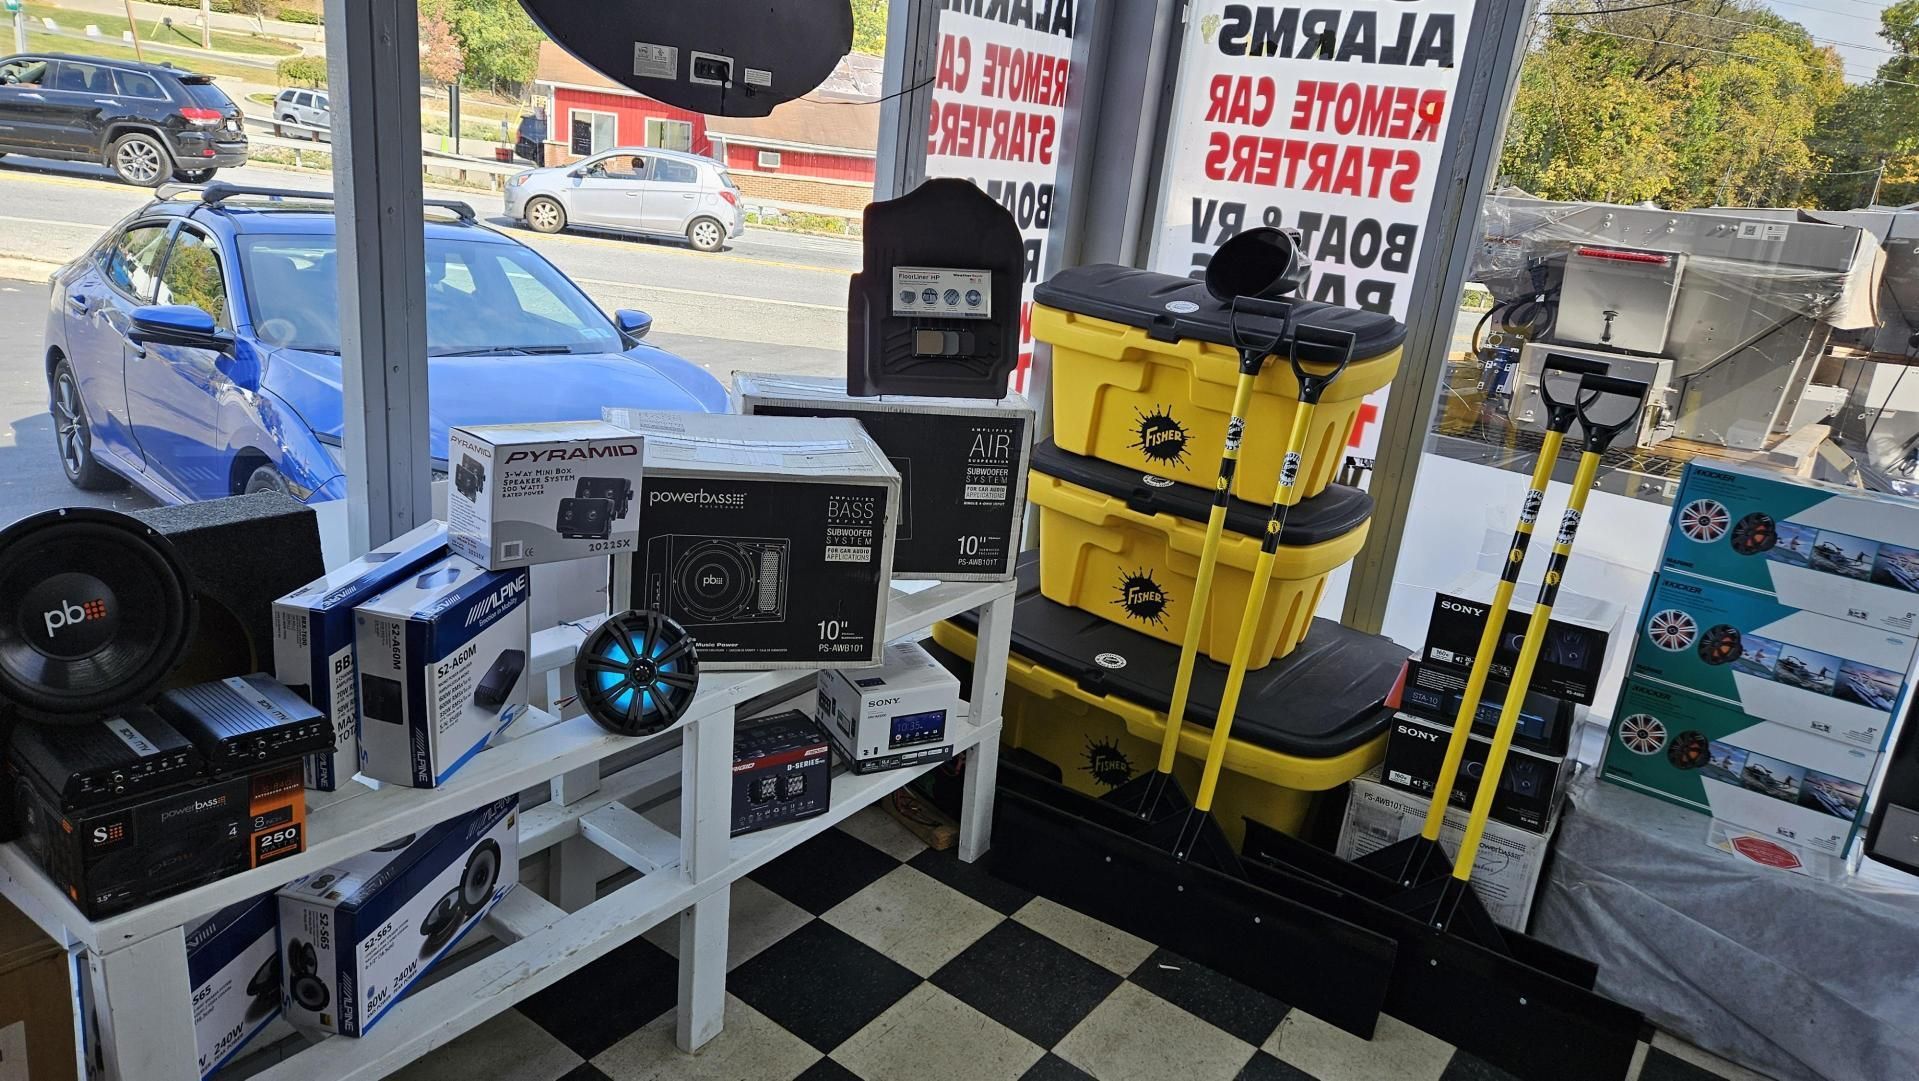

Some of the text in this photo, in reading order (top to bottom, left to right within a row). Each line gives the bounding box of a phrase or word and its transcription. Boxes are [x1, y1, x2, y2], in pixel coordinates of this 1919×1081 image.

[1145, 426, 1182, 447] FISHER
[451, 435, 492, 458] PYRAMID
[504, 444, 638, 464] PYRAMID
[969, 433, 1010, 458] AIR
[503, 474, 575, 486] SPEAKER SYSTEM
[966, 467, 1008, 476] SUBWOOFER
[966, 475, 1007, 484] SYSTEM
[1698, 470, 1736, 481] KICKER
[502, 485, 517, 493] 200
[828, 501, 874, 518] BASS
[826, 527, 873, 537] SUBWOOFER
[826, 536, 872, 545] SYSTEM
[588, 539, 630, 552] 2022SX
[957, 535, 986, 555] 10"
[958, 558, 997, 566] PS-AWB101T
[1128, 587, 1162, 605] FISHER
[1666, 581, 1702, 594] KICKER
[475, 574, 525, 621] ALPINE
[1441, 600, 1484, 617] SONY
[44, 599, 90, 637] pb
[817, 620, 848, 640] 10"
[391, 623, 401, 670] S2-A60M
[818, 643, 864, 653] PS-AWB101
[438, 643, 477, 679] S2-A60M
[1412, 691, 1438, 704] STA-10
[1635, 686, 1671, 701] KICKER
[868, 697, 900, 708] SONY
[1397, 725, 1439, 742] SONY
[787, 758, 820, 771] D-SERIES
[1095, 755, 1127, 772] FISHER
[1364, 792, 1402, 810] PS-AWB101
[261, 828, 296, 847] 250
[319, 912, 330, 950] S2-S65
[364, 922, 392, 952] S2-S65
[393, 958, 418, 988] 240W
[343, 983, 354, 1031] ALPINE
[367, 986, 388, 1012] 80W
[214, 1022, 244, 1055] 240W
